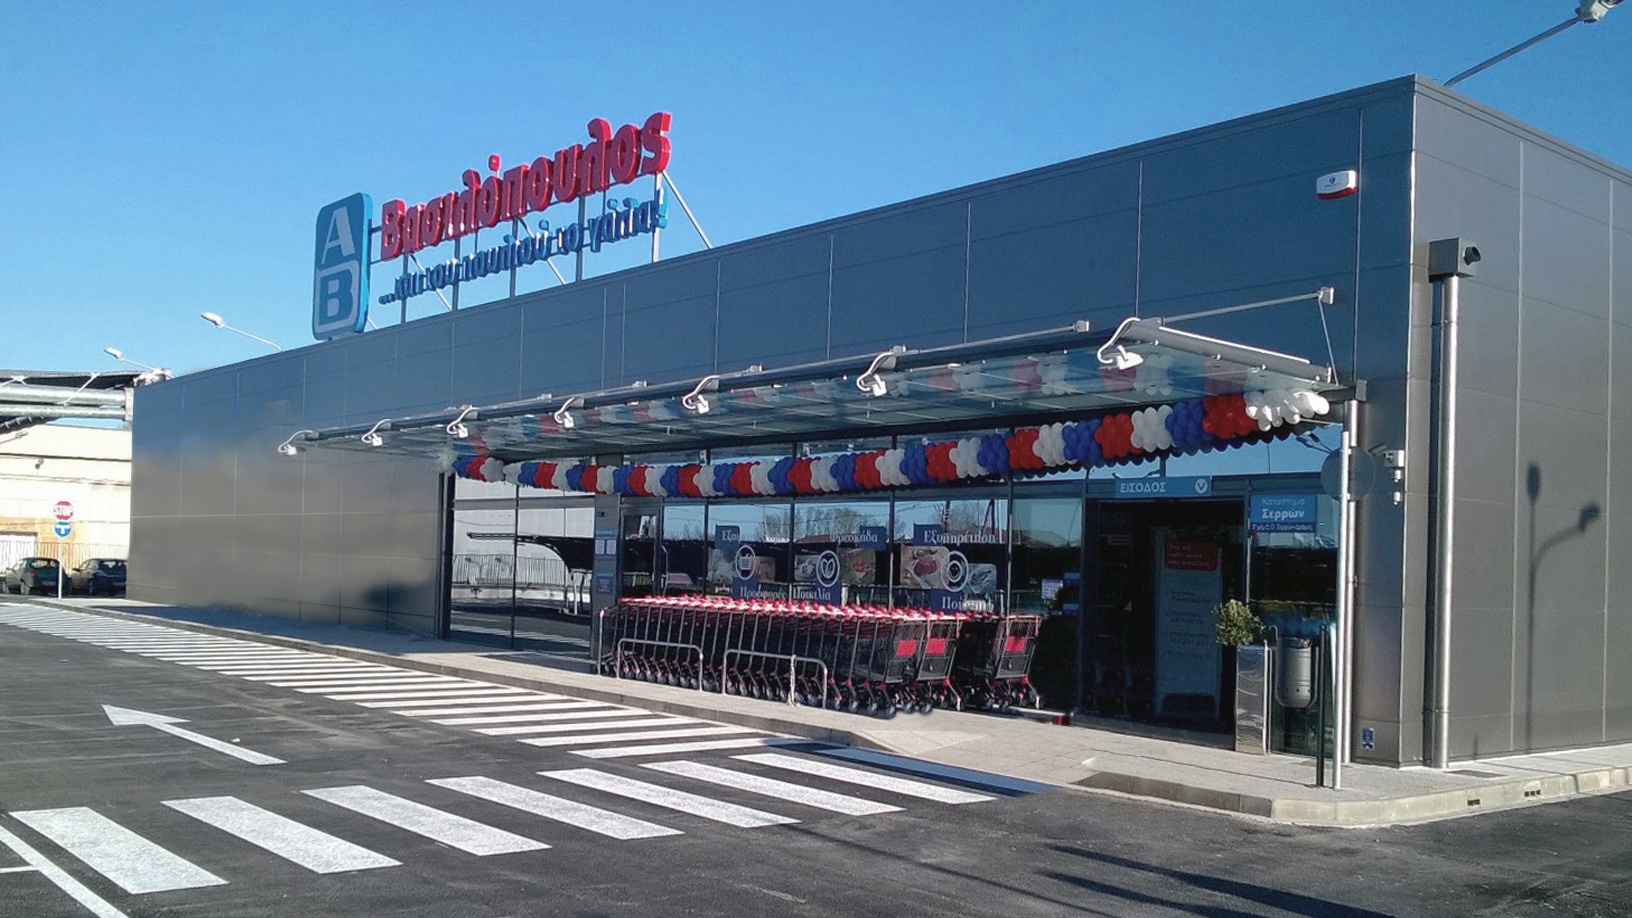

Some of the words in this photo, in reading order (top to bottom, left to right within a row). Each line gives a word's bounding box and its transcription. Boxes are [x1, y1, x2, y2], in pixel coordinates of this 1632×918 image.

[381, 112, 672, 261] Βασιλόπουλος
[1119, 482, 1167, 493] ΕΙΣΟΔΟΣ
[54, 505, 73, 516] STOP
[1262, 508, 1305, 521] Σερρών
